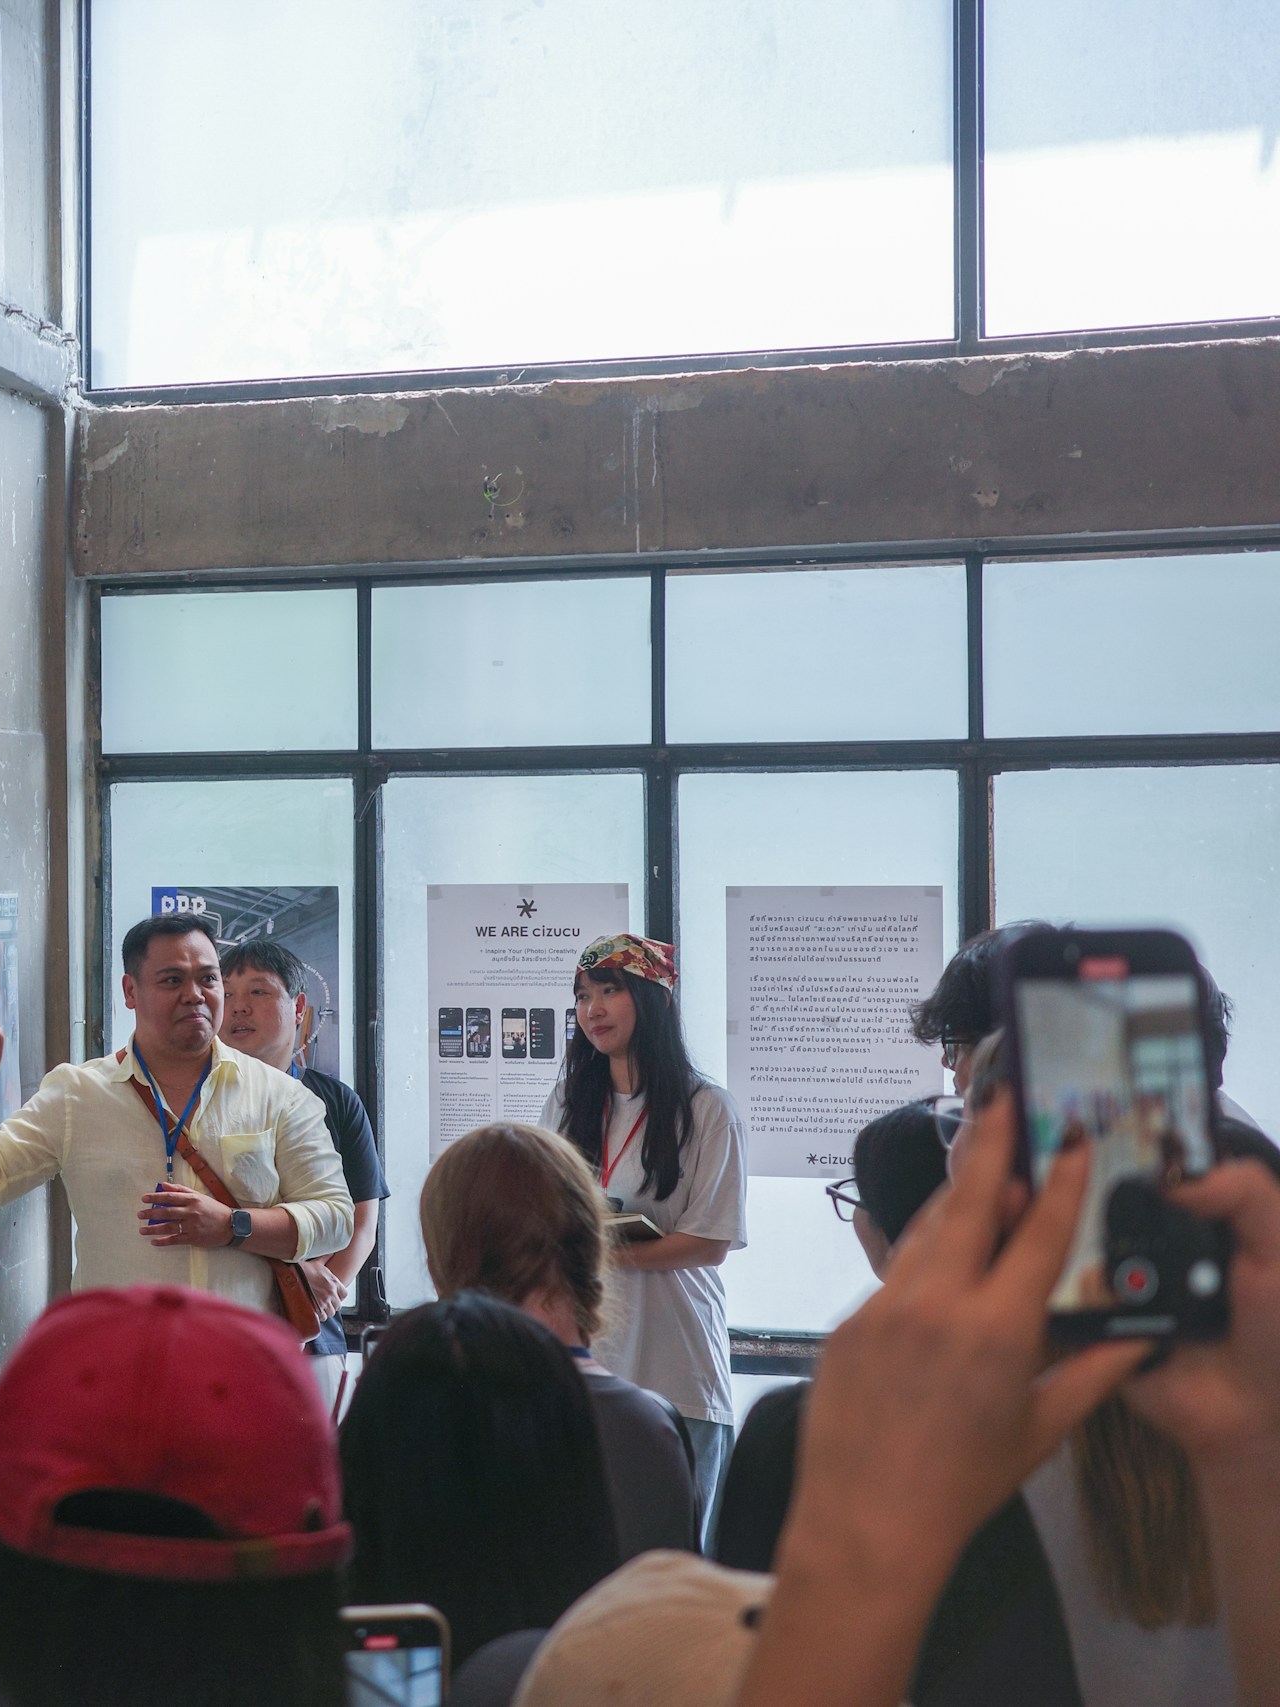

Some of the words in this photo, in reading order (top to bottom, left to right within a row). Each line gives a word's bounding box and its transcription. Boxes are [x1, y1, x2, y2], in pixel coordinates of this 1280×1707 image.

[476, 926, 496, 937] WE
[500, 926, 528, 937] ARE
[532, 925, 580, 937] cizucu
[820, 1154, 855, 1166] cizuc
